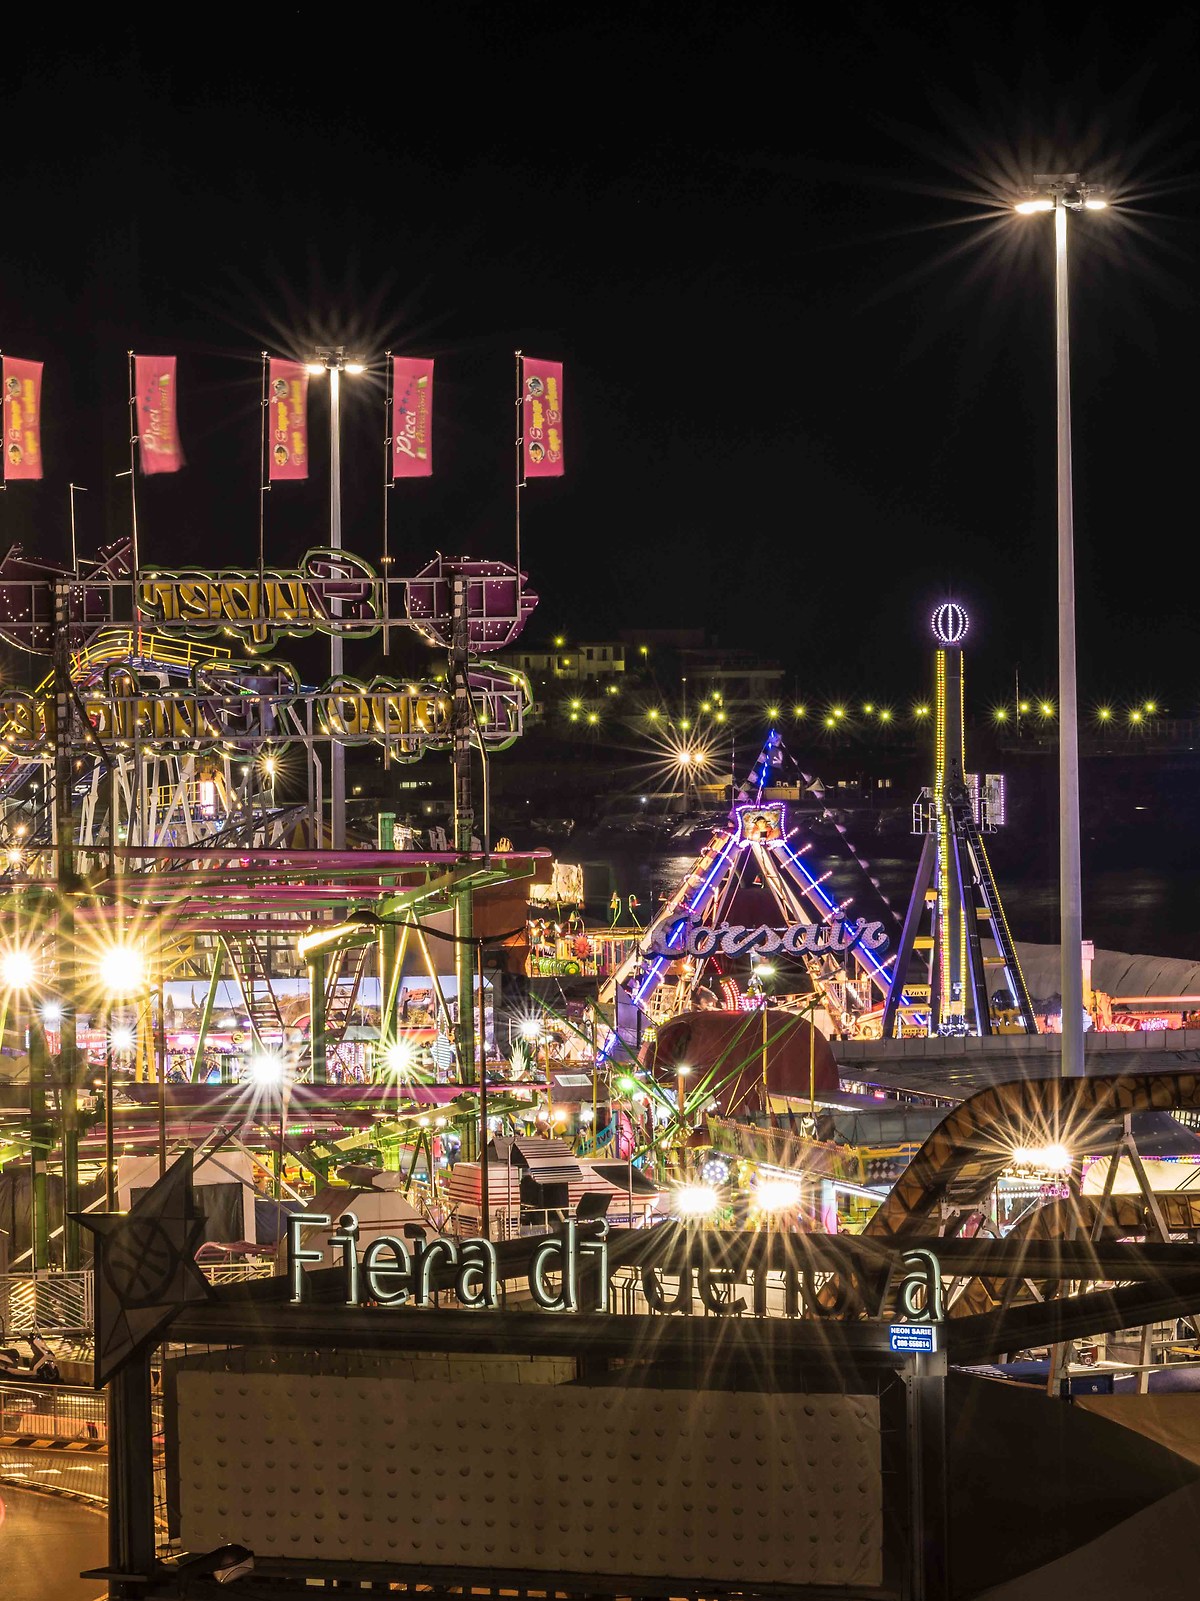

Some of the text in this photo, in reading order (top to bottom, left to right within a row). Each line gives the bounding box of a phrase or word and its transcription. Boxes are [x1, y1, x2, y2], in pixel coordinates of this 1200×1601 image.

[397, 411, 417, 459] Picci
[415, 390, 427, 445] Attrazioni
[641, 908, 890, 960] Corsair
[287, 1211, 499, 1310] Fiera
[527, 1216, 612, 1314] di
